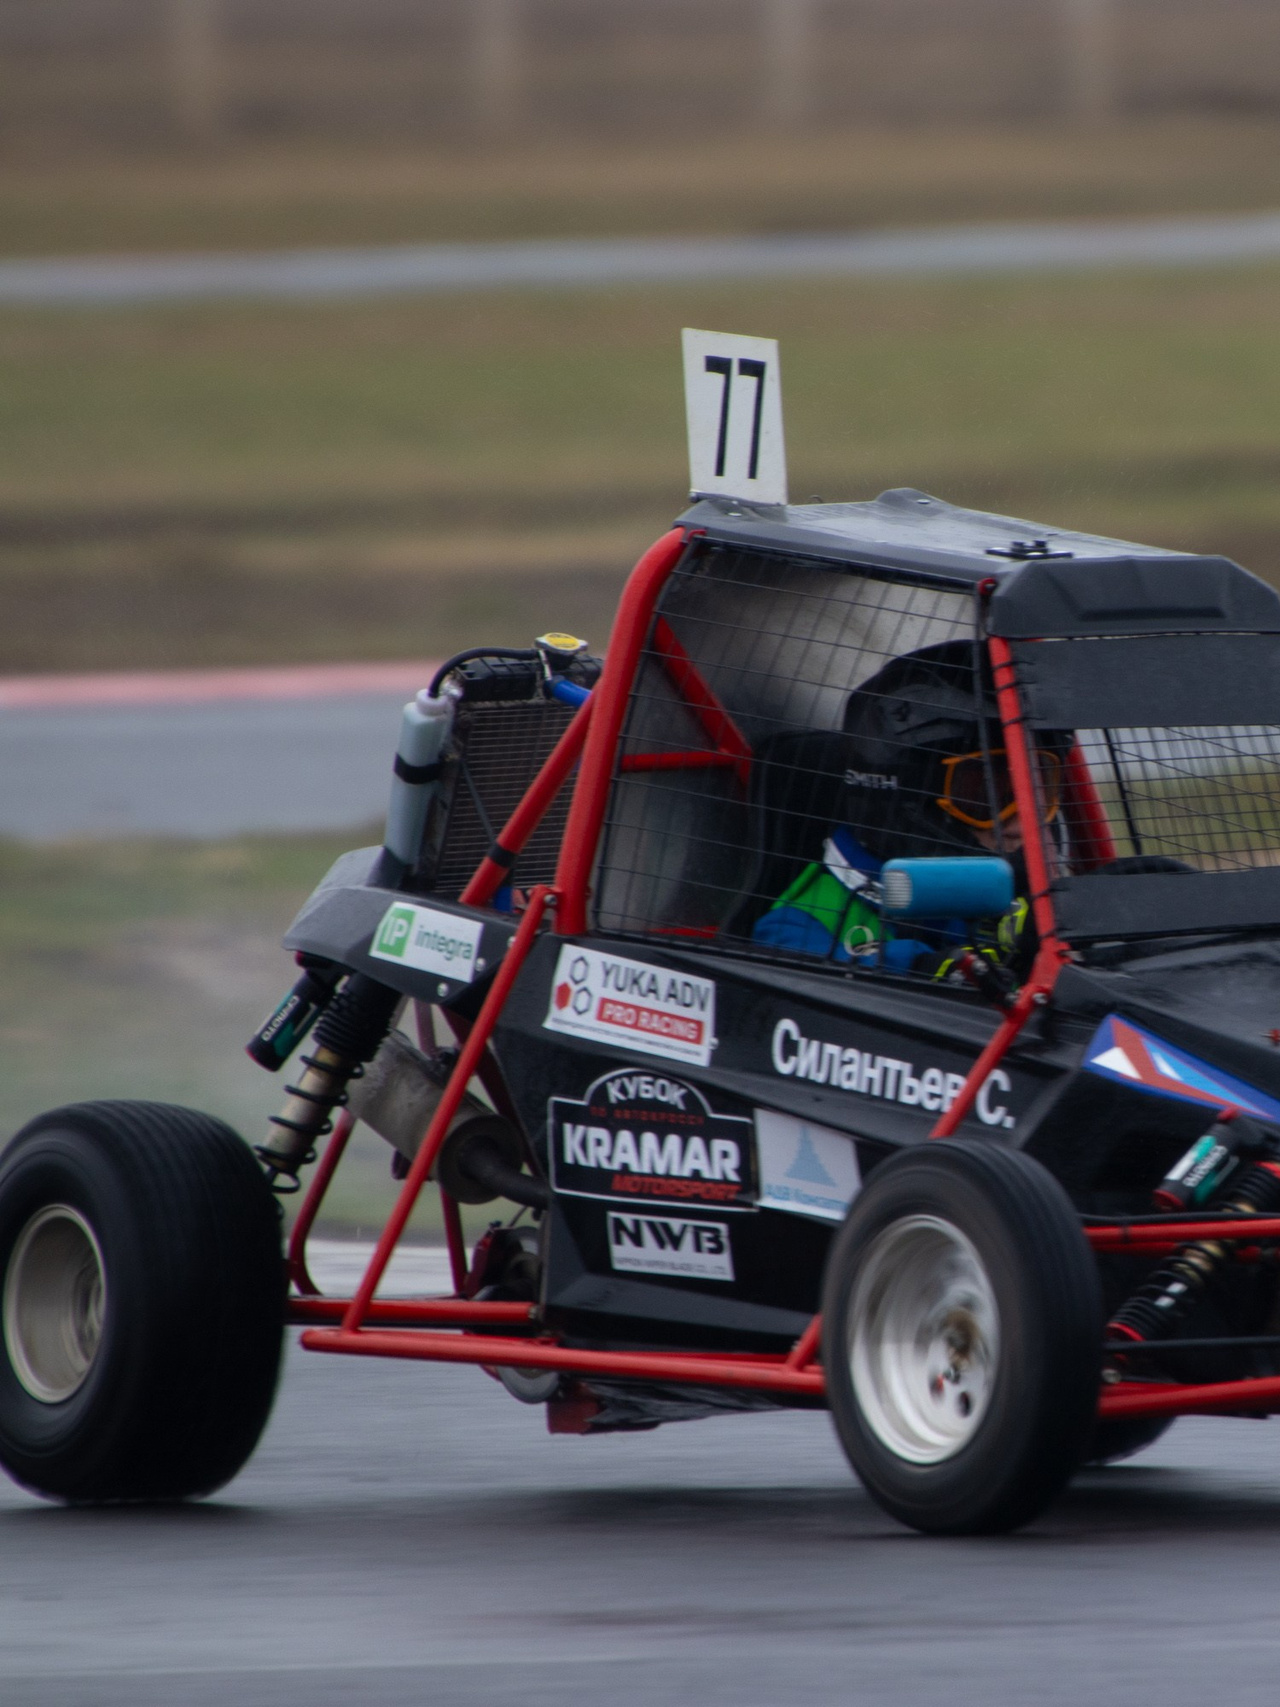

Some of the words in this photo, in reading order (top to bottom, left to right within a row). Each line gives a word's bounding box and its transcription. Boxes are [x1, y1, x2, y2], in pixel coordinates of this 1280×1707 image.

[704, 355, 766, 480] 77
[844, 768, 898, 790] SMITH
[415, 924, 474, 961] integra
[601, 961, 660, 1001] YUKA
[664, 978, 710, 1012] ADV
[602, 1002, 637, 1025] PRO
[637, 1011, 698, 1040] RACING
[606, 1076, 688, 1110] КУБОК
[563, 1123, 741, 1182] KRAMAR
[611, 1174, 742, 1200] MOTORSPORT
[612, 1216, 725, 1256] NWB
